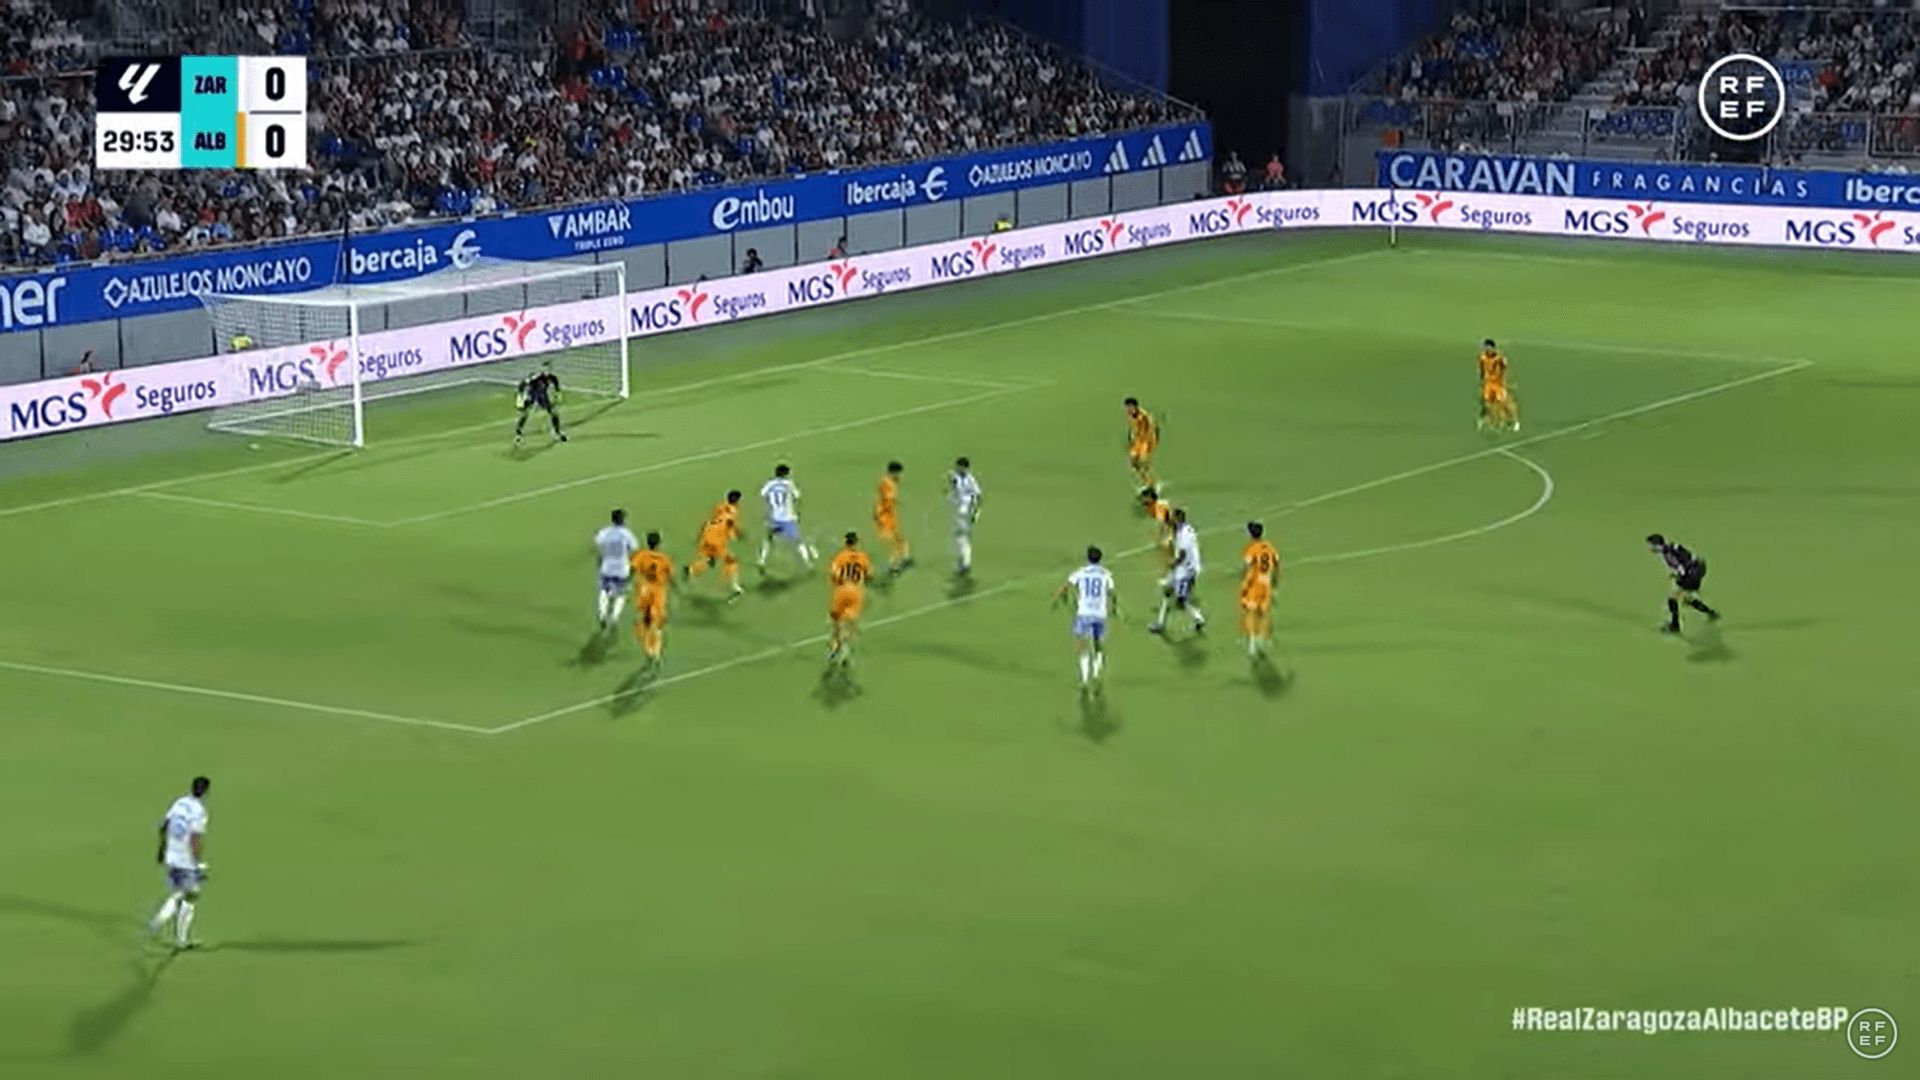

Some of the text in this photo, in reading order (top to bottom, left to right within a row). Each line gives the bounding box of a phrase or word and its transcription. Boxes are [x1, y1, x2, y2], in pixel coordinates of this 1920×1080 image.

[847, 174, 916, 205] Ibercaja
[1390, 156, 1807, 198] CARAVAN FRAGANCIAS
[564, 206, 632, 238] AMBAR
[712, 189, 794, 230] embou
[1189, 204, 1320, 234] MGS Seguros
[1352, 201, 1532, 233] MGS Seguros
[1564, 209, 1750, 240] MGS Seguros
[1064, 221, 1171, 256] MGS Seguros
[1785, 219, 1855, 245] MGS
[931, 240, 1046, 279] MGS Seguros
[128, 256, 312, 302] AZULEJOS MONCAYO
[788, 265, 912, 305] MGS Seguros
[630, 290, 766, 332] MGS Seguros
[450, 317, 605, 363] MGS Seguros
[250, 358, 314, 395] MGS
[11, 379, 216, 432] MGS Seguros
[1084, 576, 1103, 598] 18
